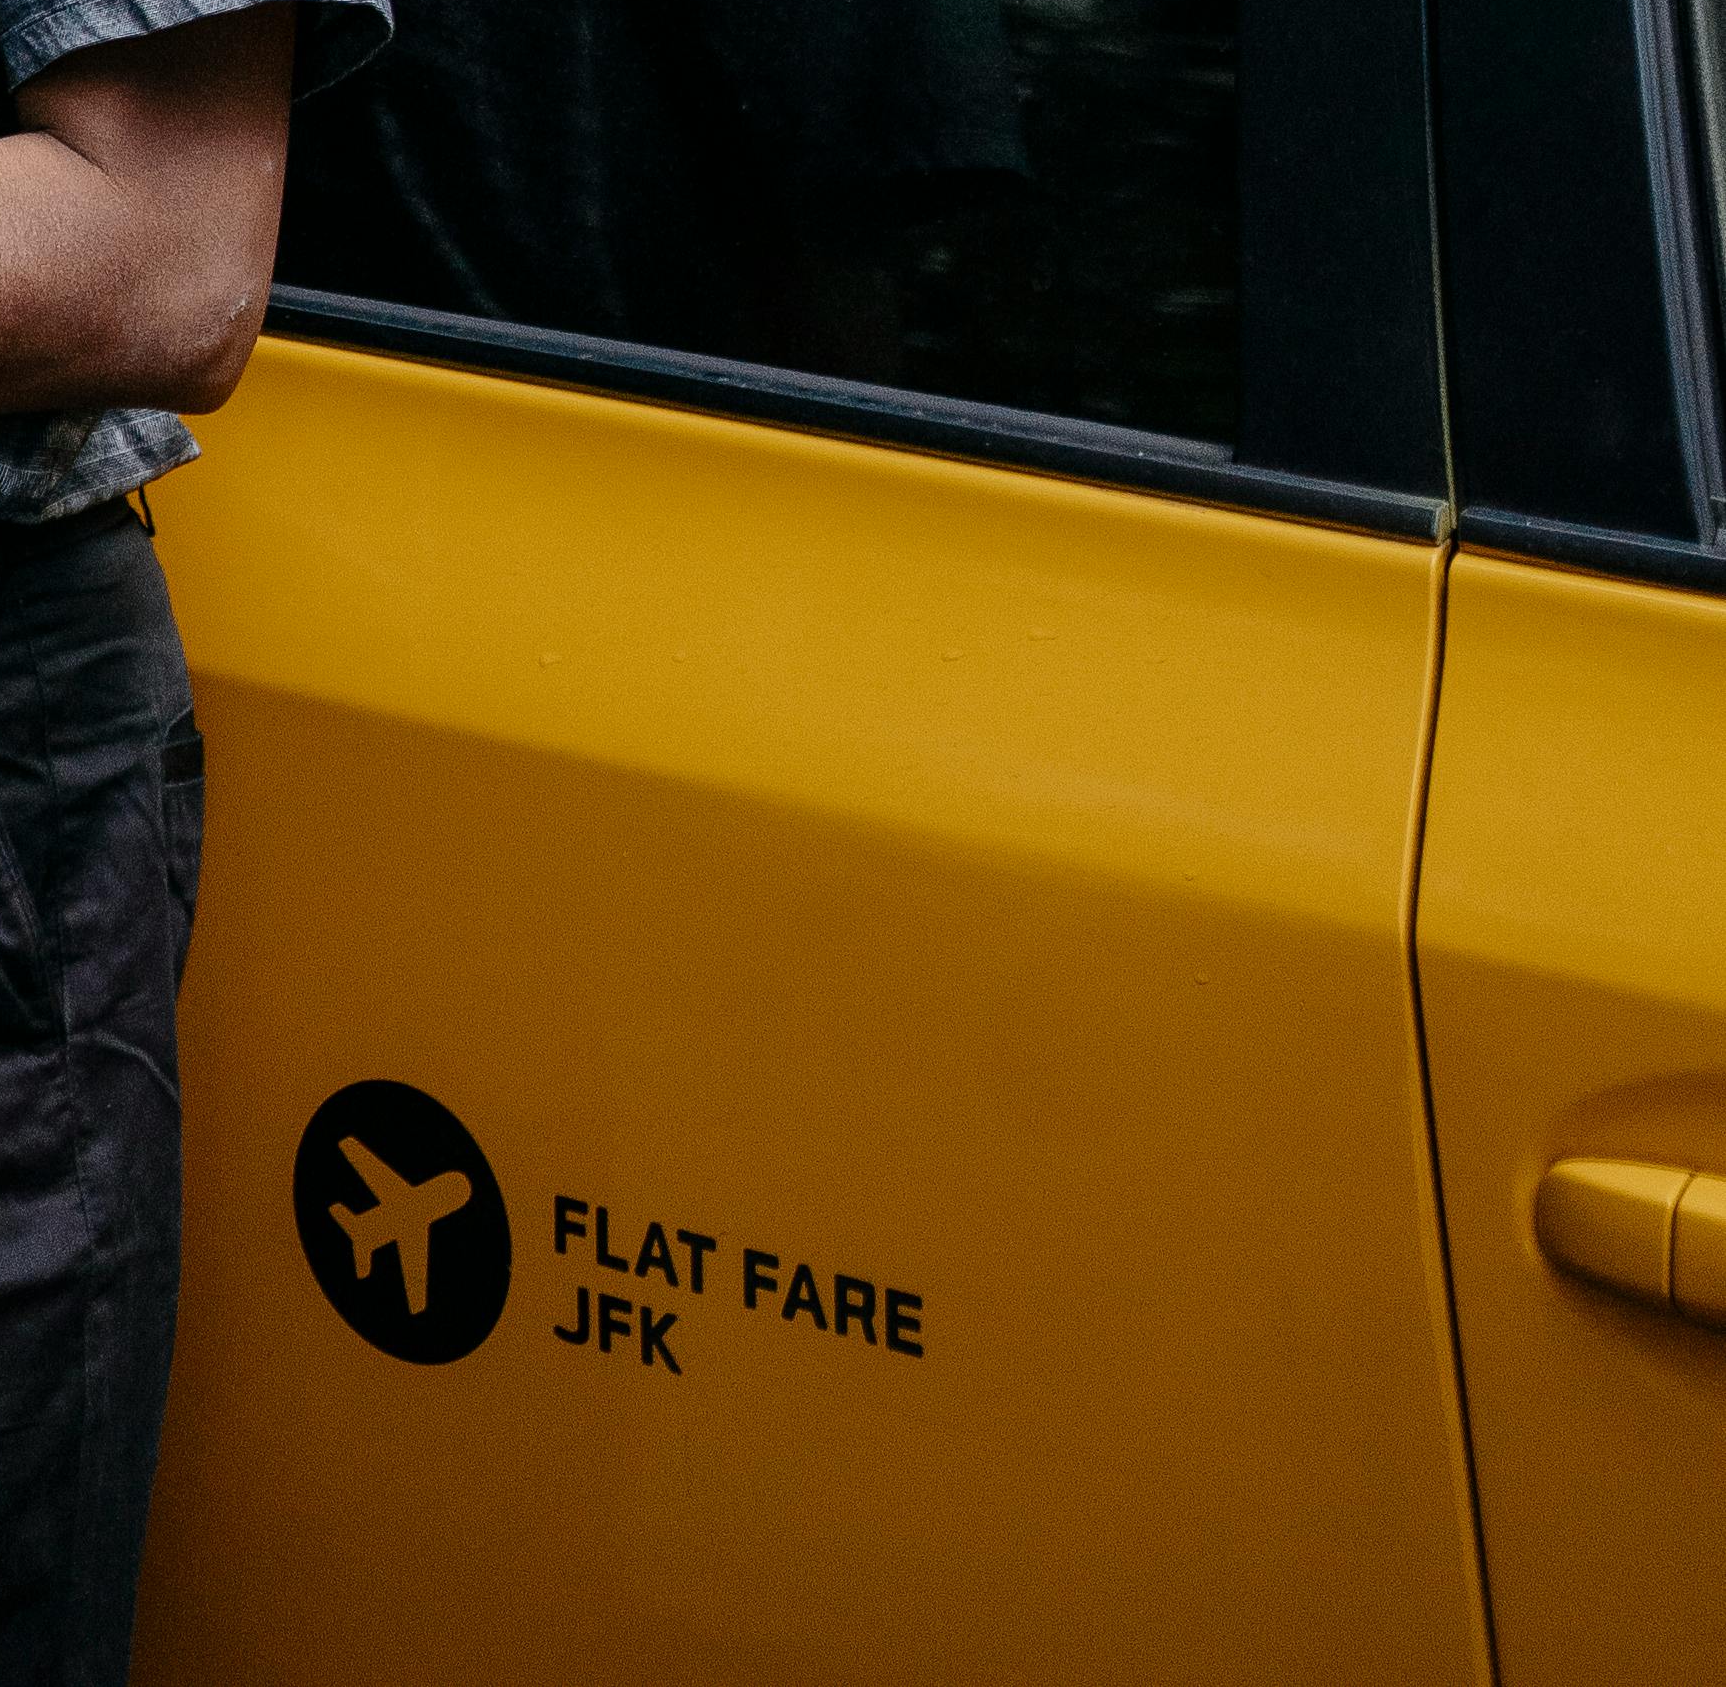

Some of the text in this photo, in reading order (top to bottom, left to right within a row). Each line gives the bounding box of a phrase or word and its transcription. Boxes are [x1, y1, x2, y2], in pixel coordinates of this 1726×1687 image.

[553, 1194, 925, 1358] FLAT FARE
[553, 1286, 682, 1375] JFK
